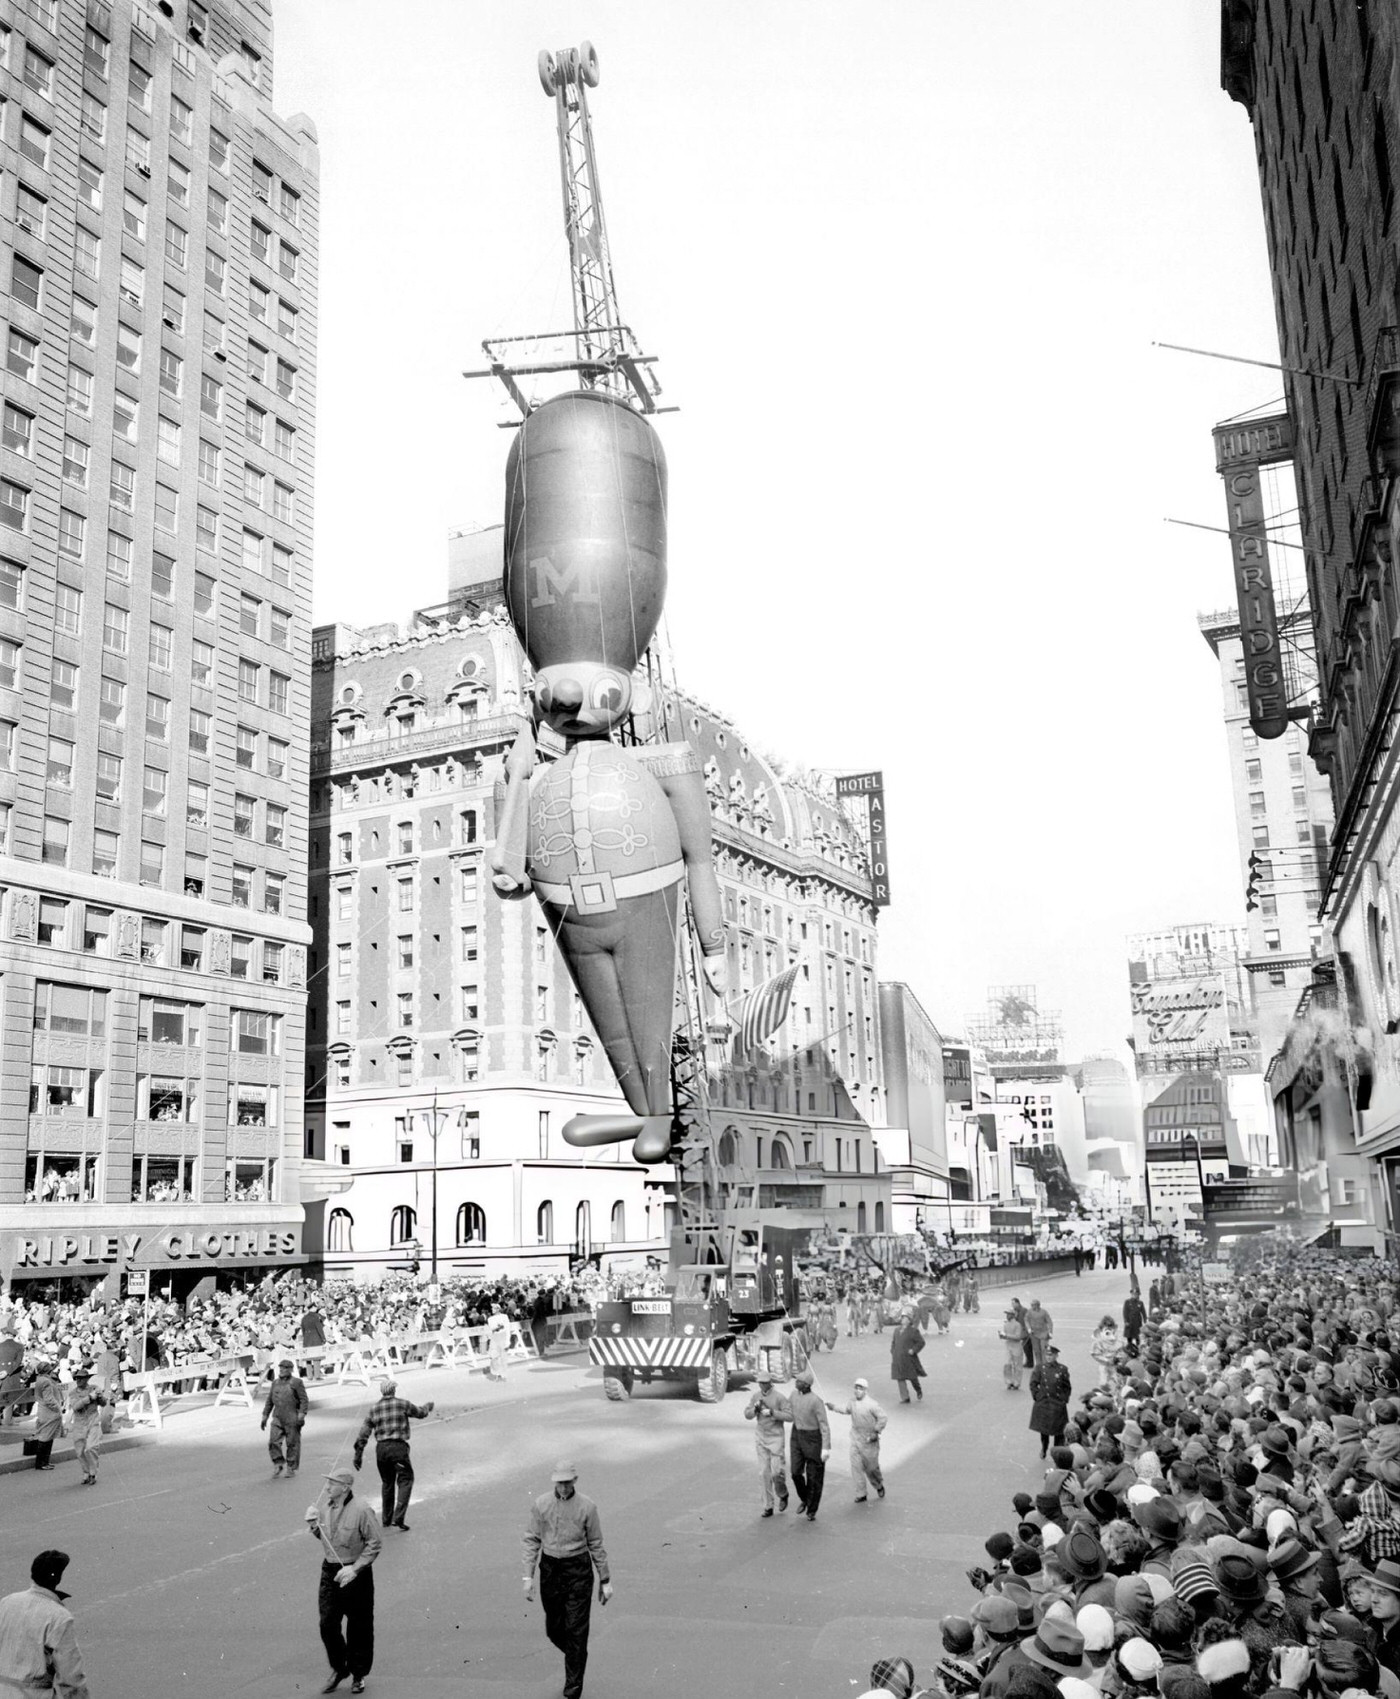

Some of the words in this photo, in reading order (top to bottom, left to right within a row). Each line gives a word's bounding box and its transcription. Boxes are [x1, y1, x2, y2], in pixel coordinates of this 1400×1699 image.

[1221, 423, 1288, 459] HOTEL
[529, 556, 601, 609] M
[1230, 472, 1281, 721] CLARIDGE
[839, 775, 880, 793] HOTEL
[871, 797, 886, 898] ASTOR
[1130, 981, 1225, 1016] Canadian
[1147, 1011, 1208, 1045] Club
[17, 1234, 142, 1267] RIPLEY
[166, 1231, 296, 1260] CLOTHES
[738, 1290, 750, 1299] 23
